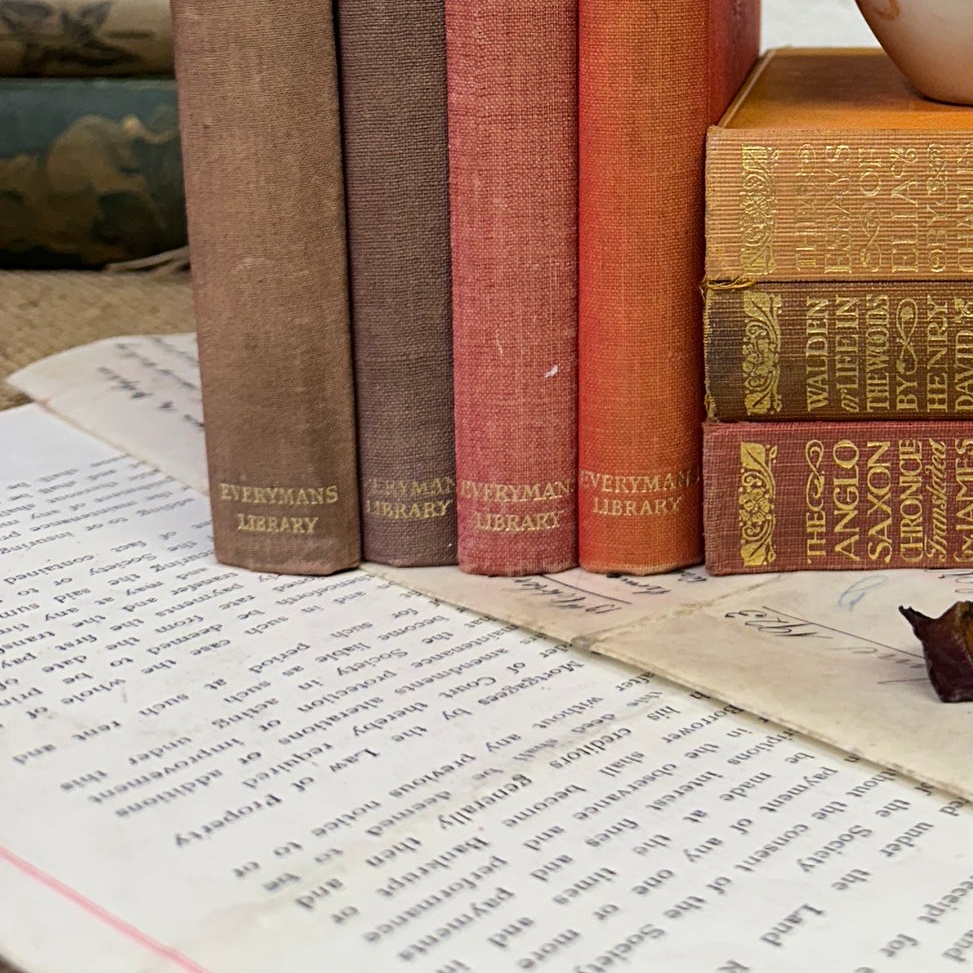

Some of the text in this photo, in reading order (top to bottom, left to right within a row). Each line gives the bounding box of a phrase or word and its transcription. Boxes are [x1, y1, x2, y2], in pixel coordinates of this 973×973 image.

[858, 148, 882, 197] OF
[891, 175, 919, 273] ELIA
[806, 296, 829, 412] WALDEN
[836, 293, 860, 413] or LIFE IN
[866, 293, 890, 413] THE WOODS
[927, 295, 948, 413] HENRY
[896, 374, 918, 412] BY
[473, 509, 565, 531] LIBRARY
[592, 497, 682, 516] LIBRARY
[833, 439, 860, 562] ANGLO
[867, 440, 892, 563] SAXON
[899, 438, 923, 563] CHRONICLE
[924, 438, 948, 563] Translated
[237, 513, 319, 534] LIBRARY
[806, 510, 827, 564] THE
[145, 623, 223, 656] deemed
[222, 615, 450, 704] become liable such
[248, 642, 311, 674] period
[41, 654, 88, 674] date
[393, 648, 509, 695] amendments
[60, 678, 127, 705] whole
[127, 631, 454, 766] the Society in acting under
[138, 693, 190, 717] such
[296, 669, 398, 713] protection
[71, 720, 122, 742] rent
[241, 676, 497, 790] Court thereby required
[277, 696, 384, 746] alterations
[532, 696, 604, 729] without
[646, 705, 681, 722] his
[174, 659, 586, 848] Mortgagees by the Law Property
[485, 733, 522, 753] any
[548, 727, 632, 770] creditors
[684, 743, 720, 760] the
[784, 752, 816, 765] be
[88, 737, 245, 804] improvement
[388, 753, 477, 798] previous
[598, 751, 646, 778] shall
[437, 773, 533, 830] generally
[501, 784, 588, 828] become
[572, 763, 678, 821] observance
[645, 770, 724, 812] interest
[719, 771, 773, 802] made
[759, 766, 839, 813] payment
[311, 800, 382, 837] notice
[584, 818, 640, 848] fines
[682, 809, 708, 824] at
[729, 818, 754, 836] of
[796, 798, 912, 873] the Society
[365, 837, 422, 868] then
[522, 825, 565, 852] and
[632, 834, 673, 857] the
[663, 800, 848, 919] the consent of the
[683, 837, 724, 863] any
[376, 836, 491, 898] Bankrupt
[529, 854, 574, 883] and
[552, 867, 618, 906] times
[631, 869, 675, 896] one
[759, 822, 935, 948] under the Land
[879, 933, 919, 958] for
